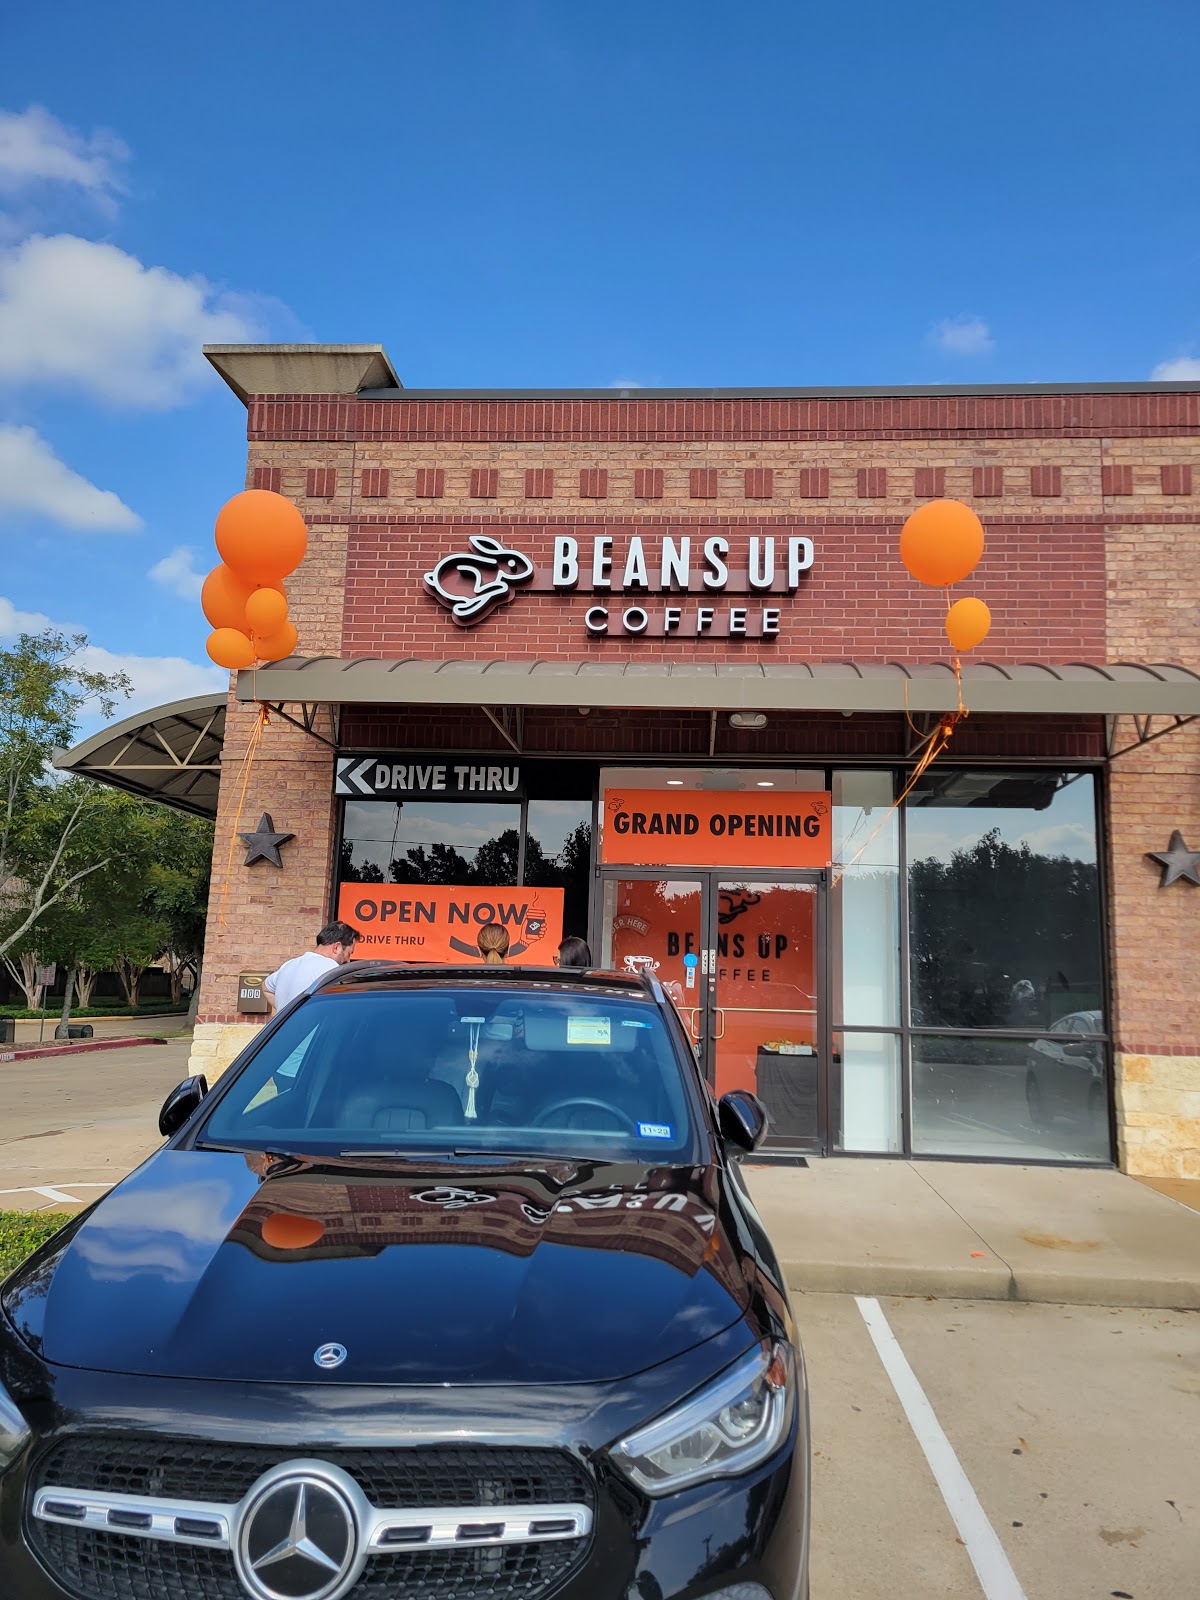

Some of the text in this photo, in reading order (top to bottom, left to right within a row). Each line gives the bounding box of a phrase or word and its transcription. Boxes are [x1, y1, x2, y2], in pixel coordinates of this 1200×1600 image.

[553, 536, 815, 589] BEANS UP
[584, 606, 781, 635] COFFEE
[375, 764, 520, 792] DRIVE THRU
[613, 811, 821, 838] GRAND OPENING
[354, 899, 529, 926] OPEN NOW
[626, 917, 648, 932] HERE
[358, 934, 425, 946] DRIVE THRU
[667, 931, 789, 959] BENS UP
[241, 989, 260, 998] 100
